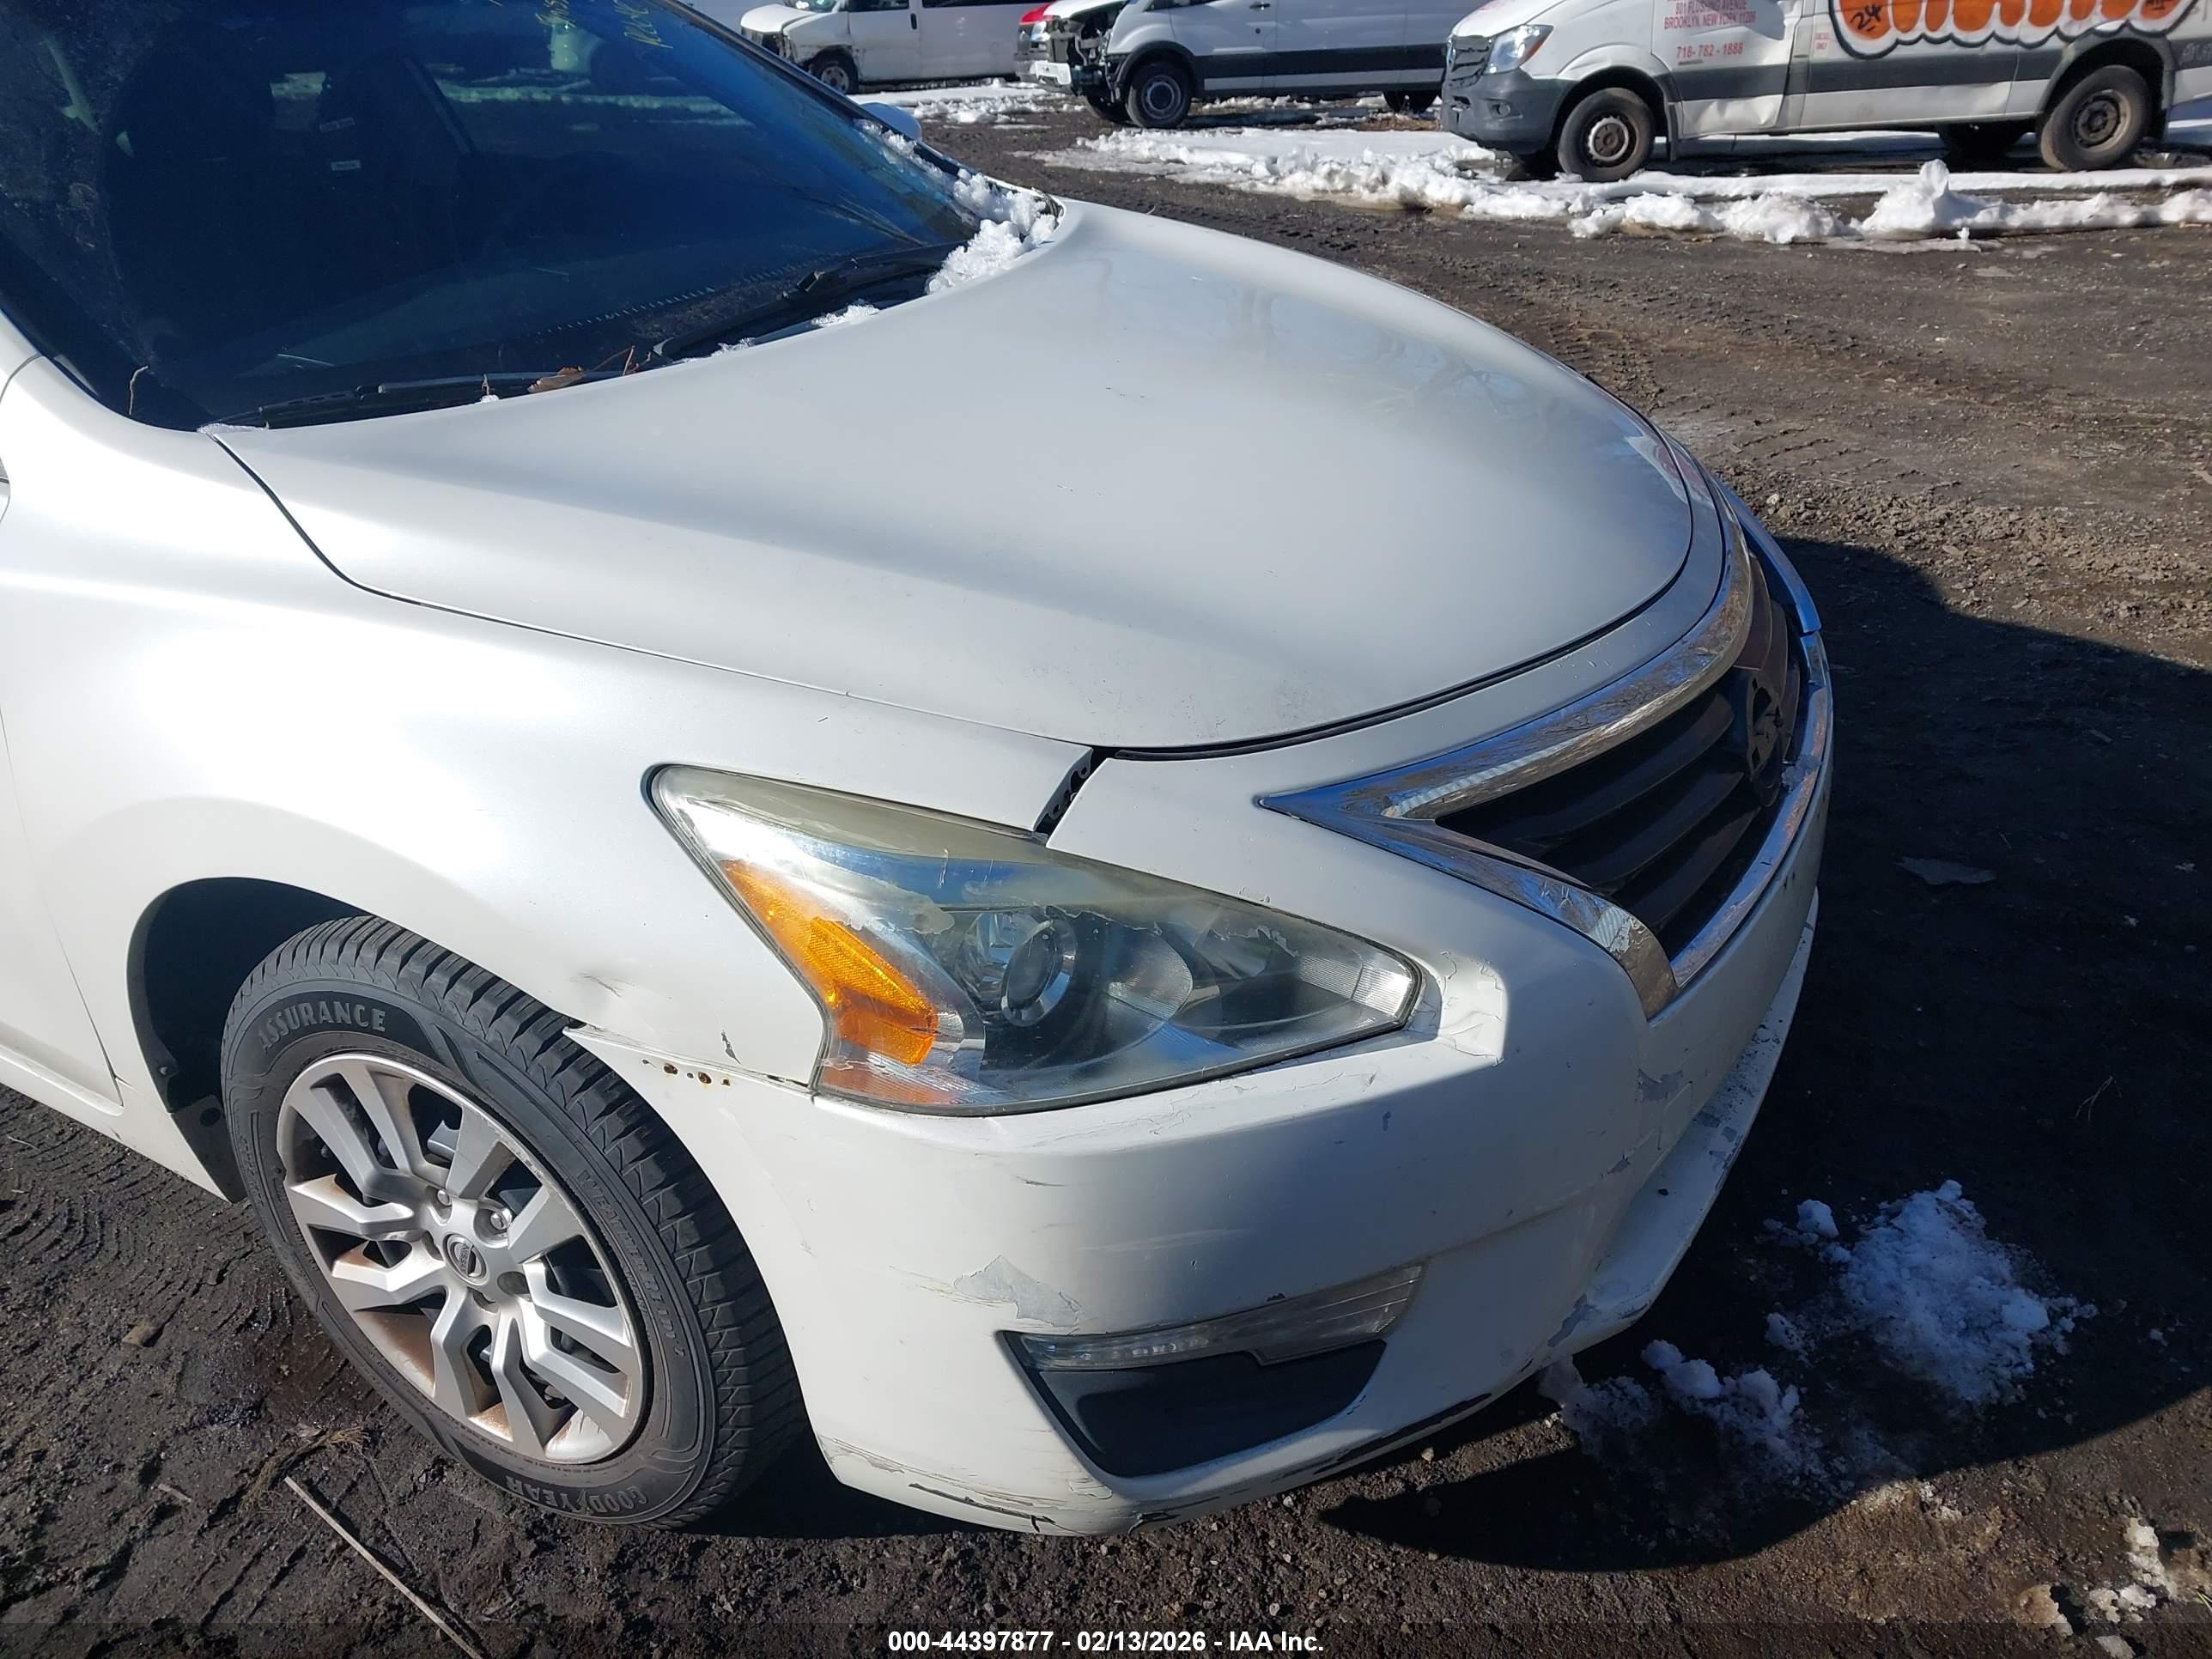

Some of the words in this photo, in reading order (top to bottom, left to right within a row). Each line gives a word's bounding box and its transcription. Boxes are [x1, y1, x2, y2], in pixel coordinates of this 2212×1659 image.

[1703, 13, 1718, 27] NEW
[259, 1000, 386, 1054] ASSURANCE
[505, 1474, 647, 1514] GOODYEAR
